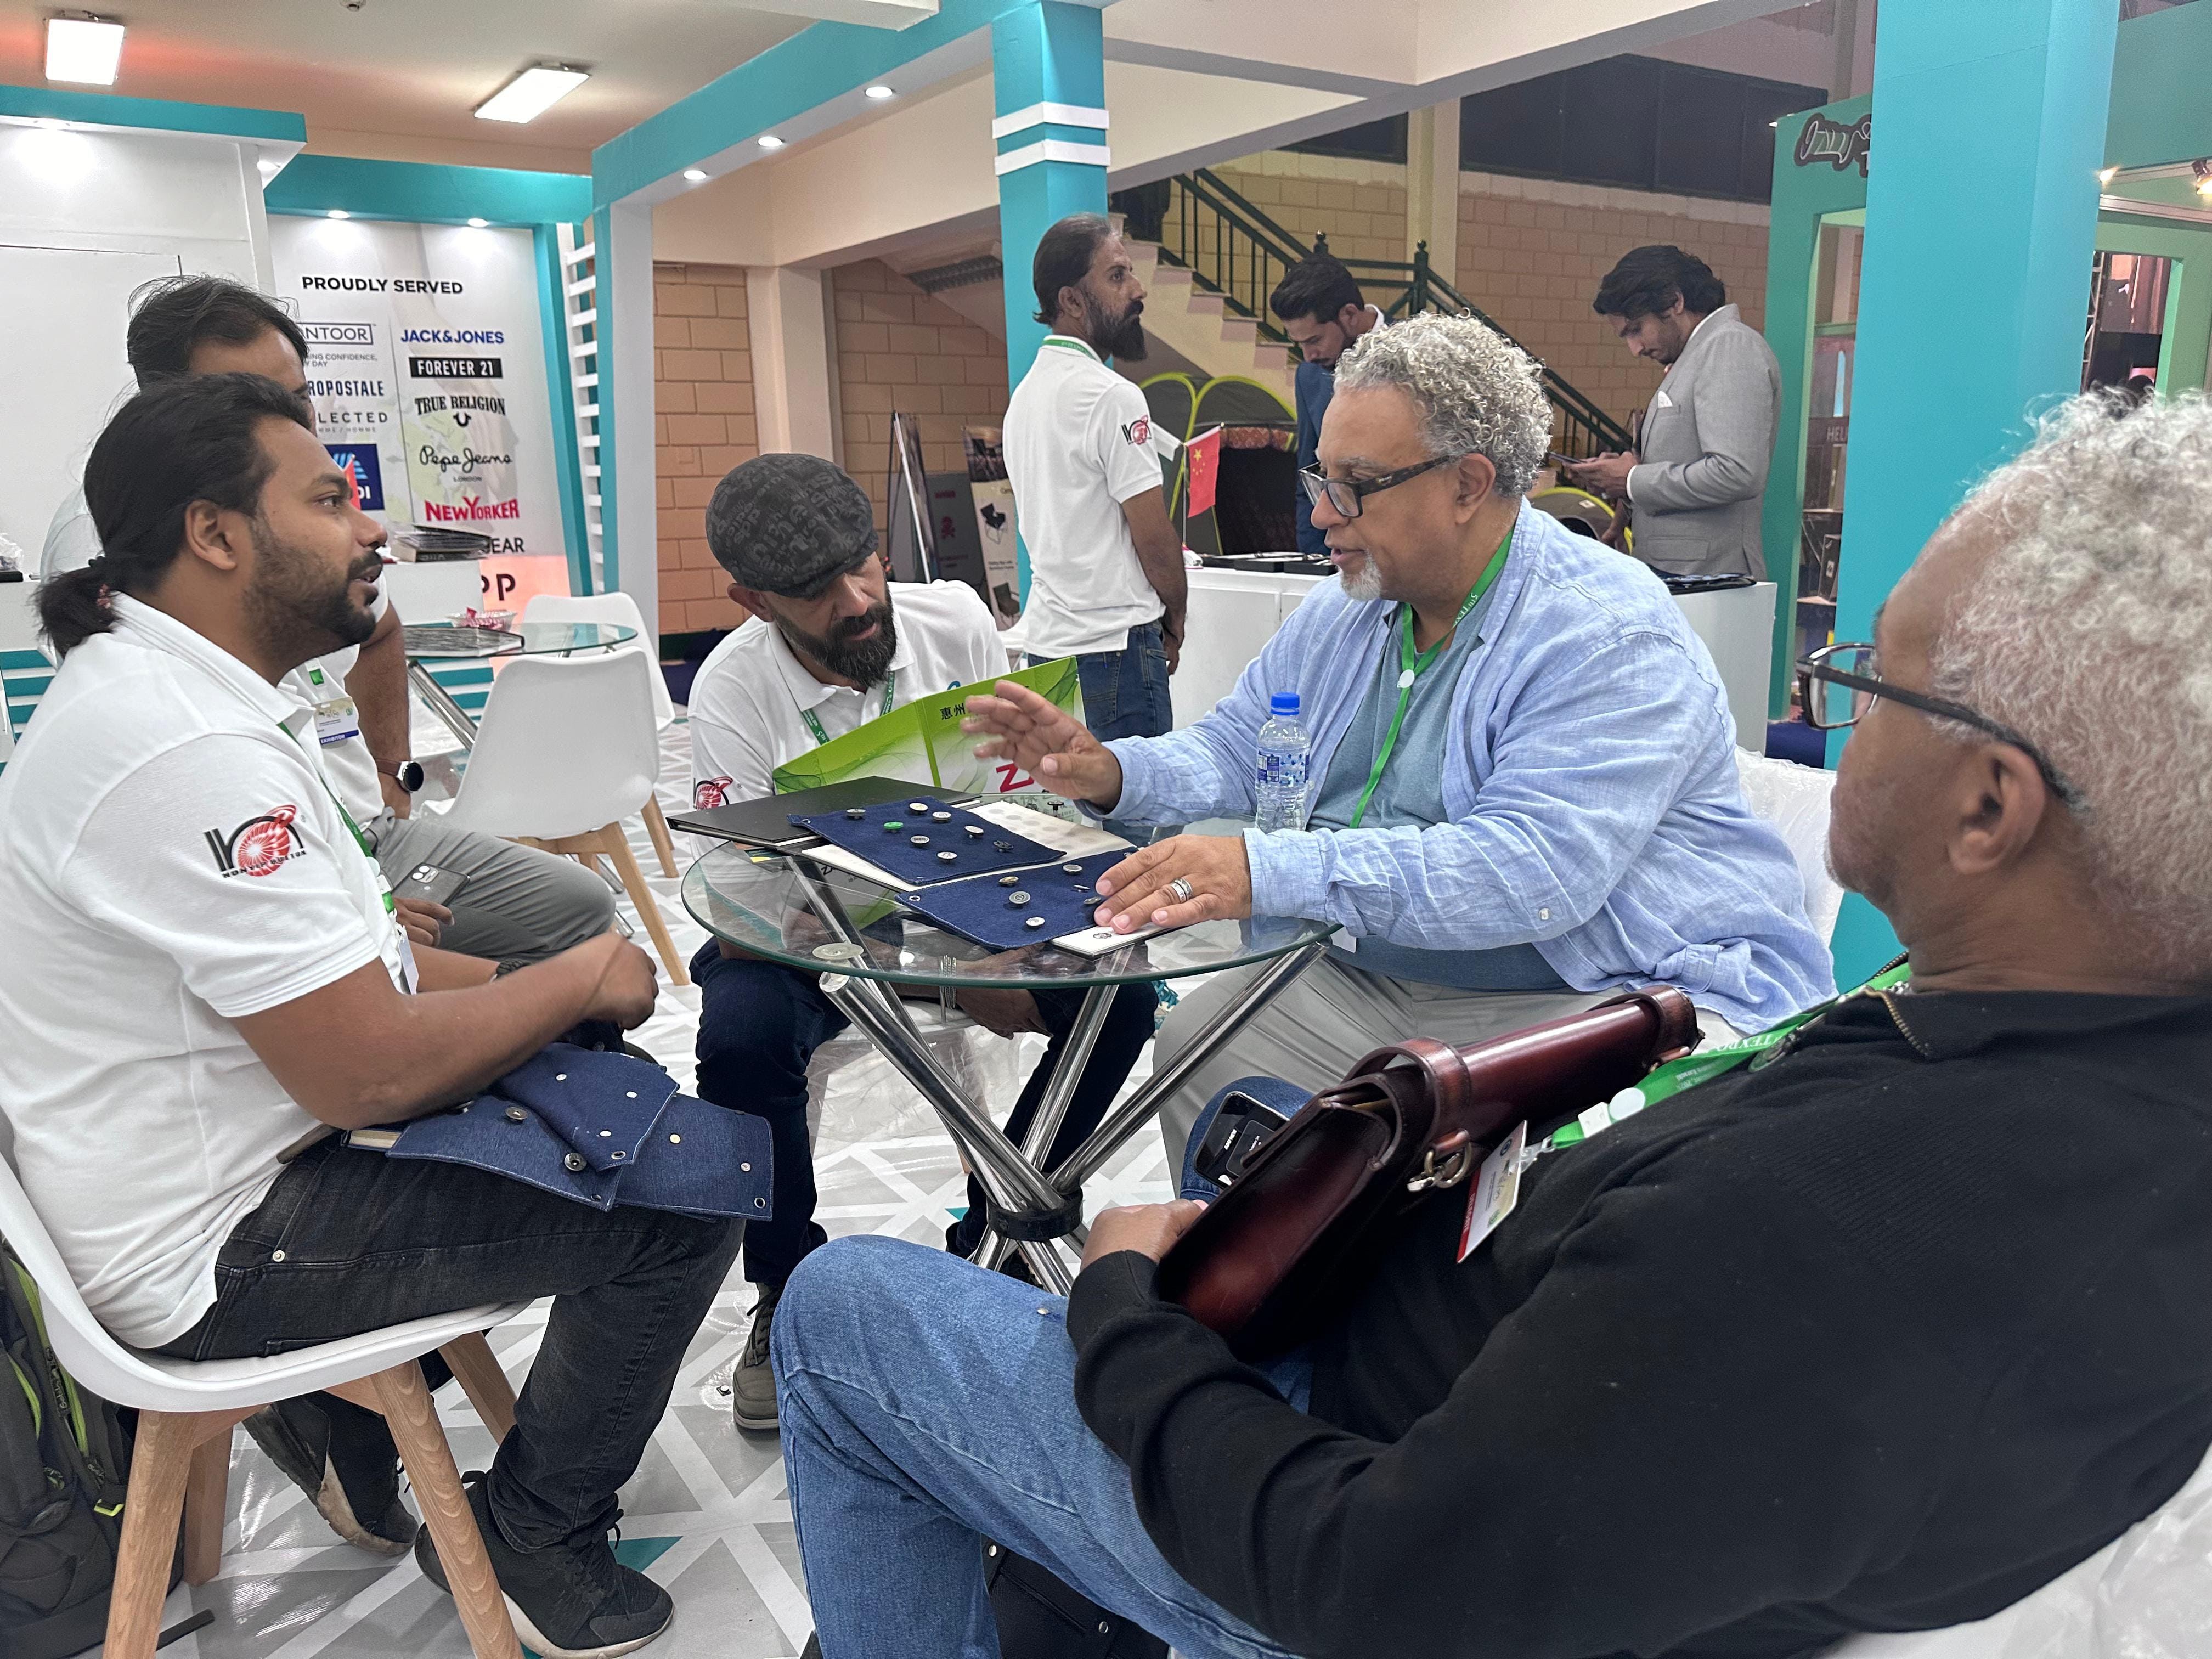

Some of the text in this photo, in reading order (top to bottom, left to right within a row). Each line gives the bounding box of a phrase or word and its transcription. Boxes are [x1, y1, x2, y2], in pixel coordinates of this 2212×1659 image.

[302, 276, 463, 294] PROUDLY SERVED
[304, 326, 368, 341] NTOOR
[400, 329, 505, 344] JACK&JONES
[417, 359, 494, 376] FOREVER 21
[307, 380, 385, 397] ROPOSTALE
[414, 395, 506, 416] TRUE RELIGION
[318, 412, 388, 424] LECTED
[419, 444, 513, 473] Pepe Jeans
[485, 537, 526, 553] EAR
[939, 702, 966, 720] 惠州
